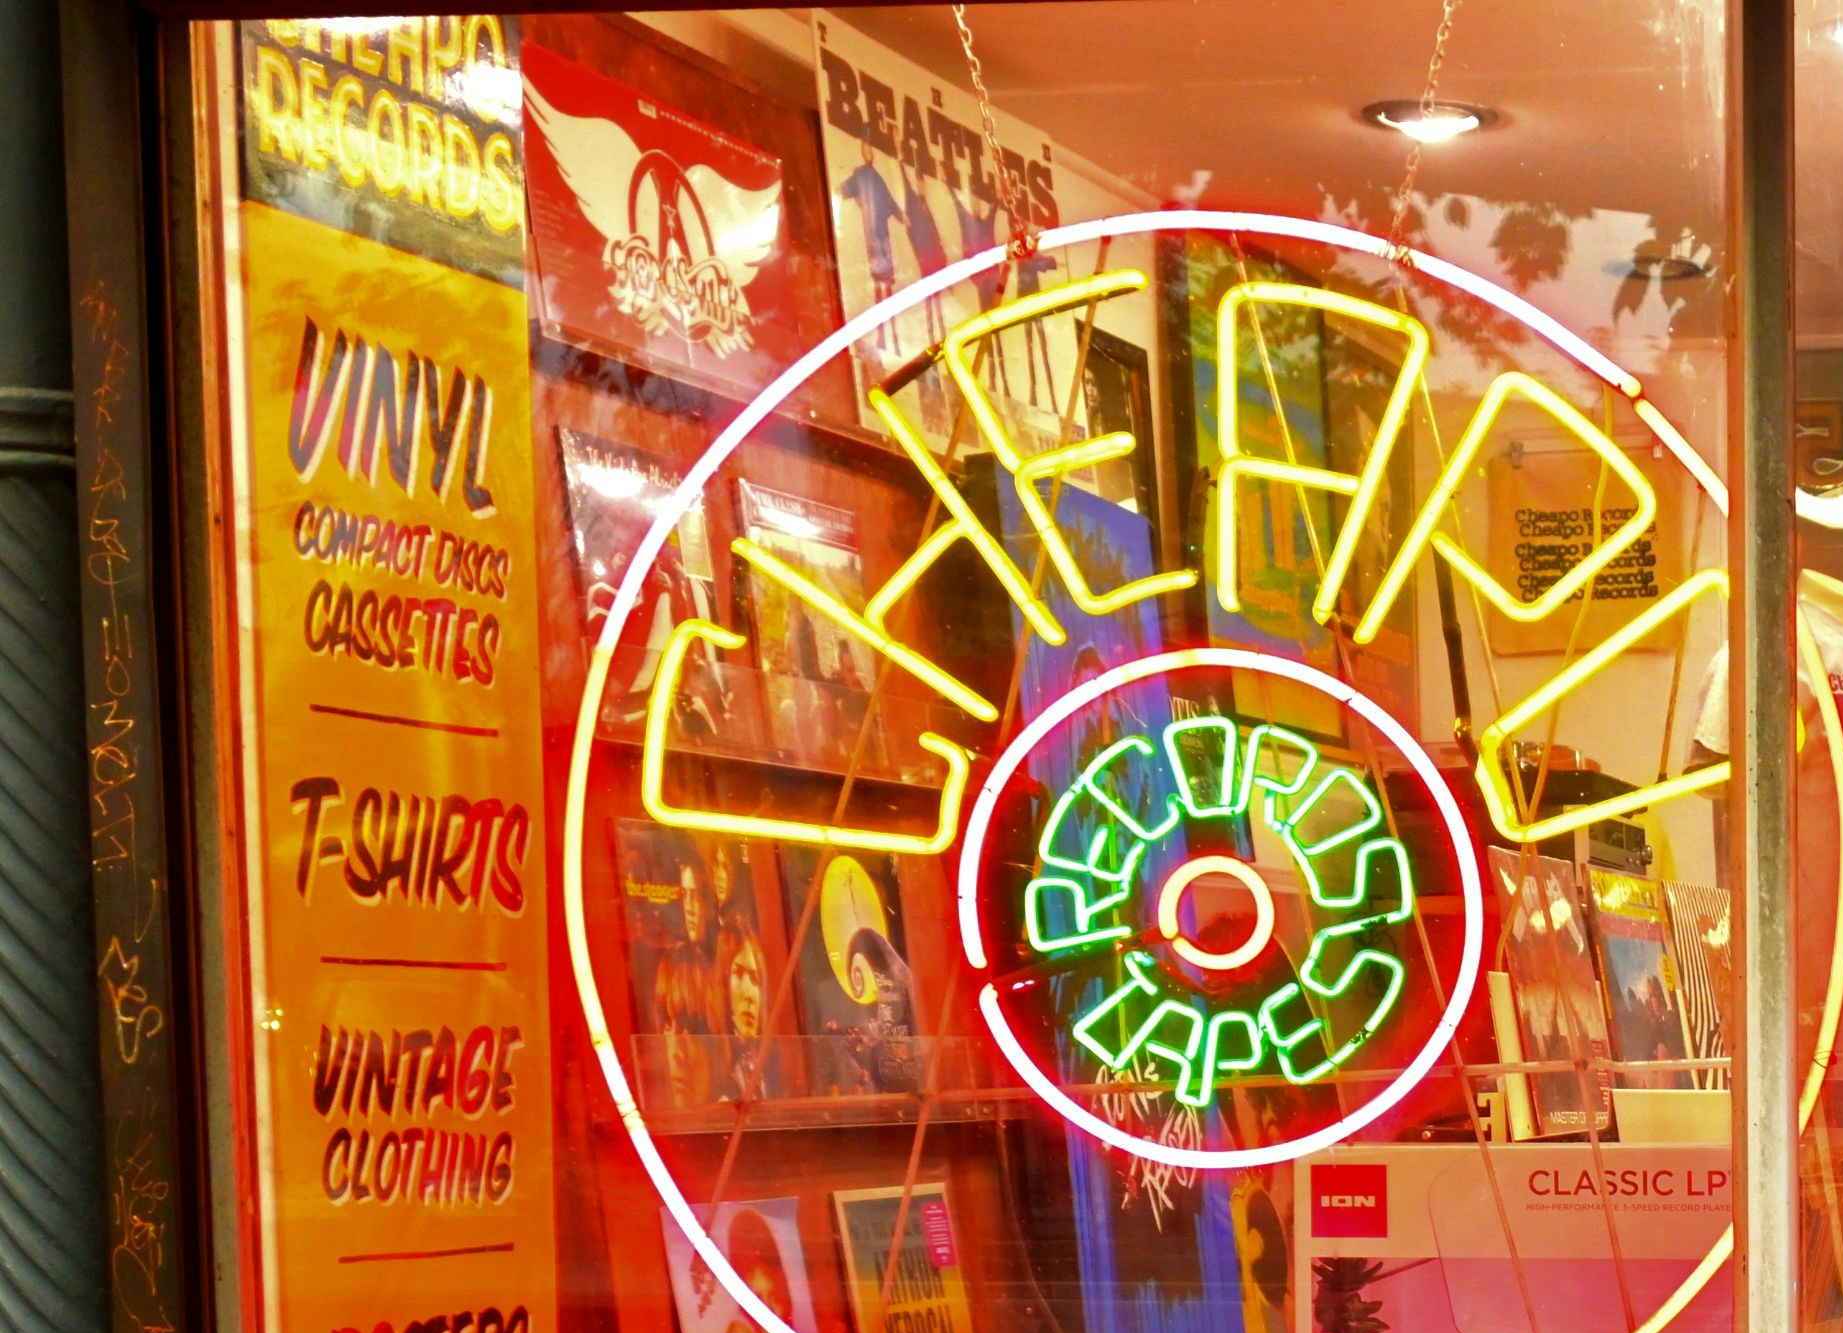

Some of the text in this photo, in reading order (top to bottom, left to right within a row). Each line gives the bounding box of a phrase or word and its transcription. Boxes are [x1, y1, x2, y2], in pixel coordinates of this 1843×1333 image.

[264, 15, 507, 122] APO
[257, 45, 519, 232] RECORDS
[820, 47, 1060, 230] BEATLES
[287, 314, 497, 518] VINYL
[293, 500, 511, 600] COMPACT DISCS
[642, 267, 1730, 857] CHEAPO
[1594, 584, 1659, 600] ecords
[303, 578, 500, 689] CASSETTES
[291, 776, 532, 918] T-SHIRTS
[1024, 716, 1414, 954] RECORDS
[1072, 922, 1405, 1107] TAPES
[313, 1024, 524, 1126] VINTAGE
[321, 1127, 516, 1208] CLOTHING
[1320, 1195, 1376, 1207] ION
[1528, 1169, 1728, 1197] CLASSIC LP
[1662, 1203, 1701, 1212] RECORD
[1702, 1203, 1731, 1212] PLAYE
